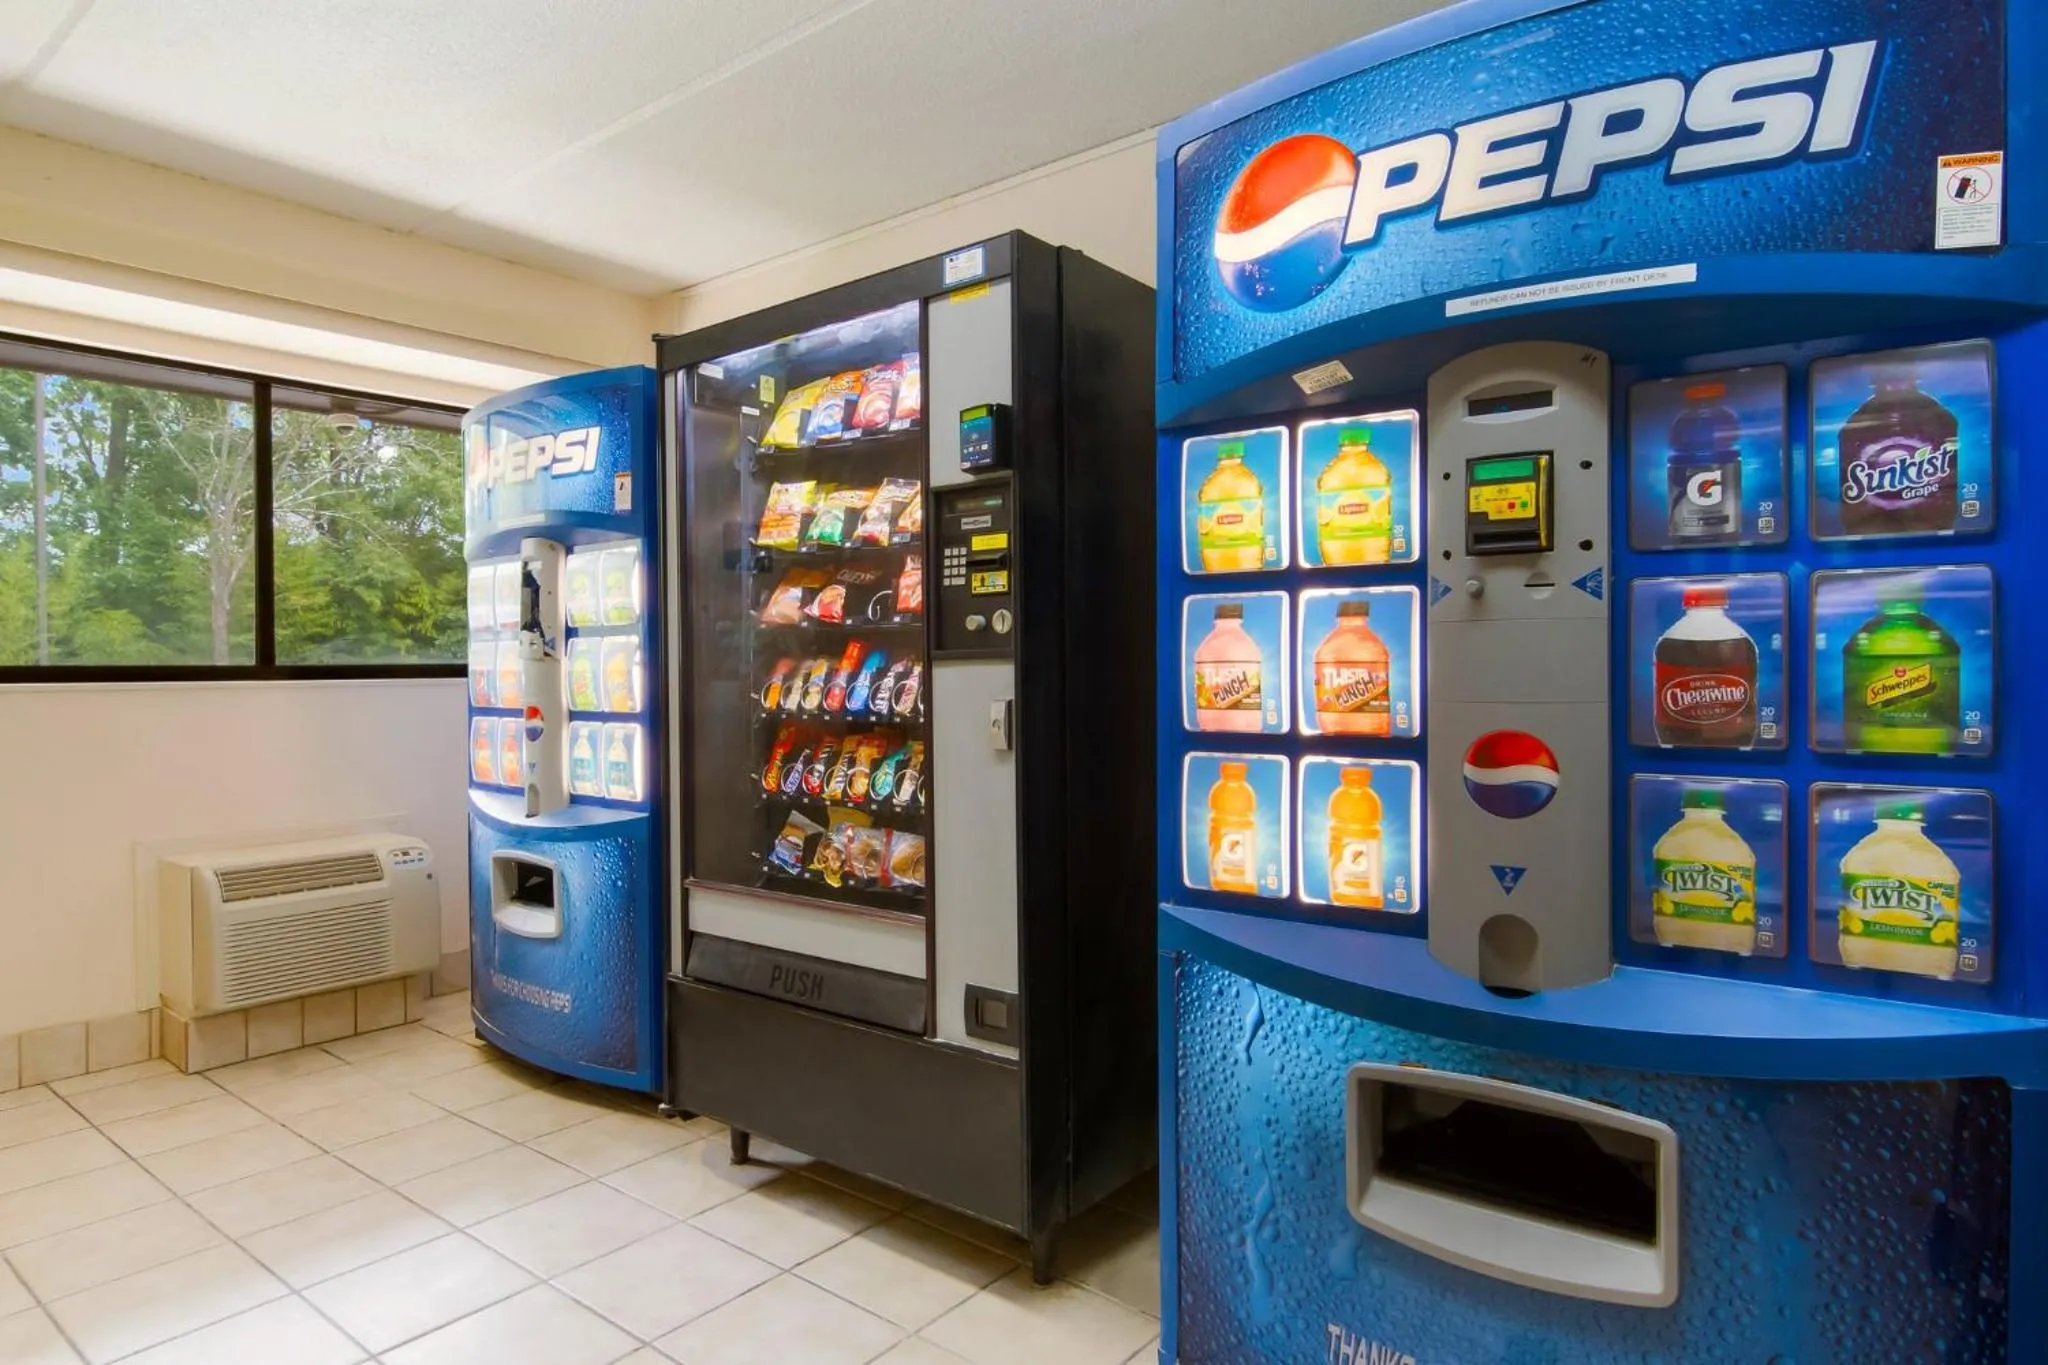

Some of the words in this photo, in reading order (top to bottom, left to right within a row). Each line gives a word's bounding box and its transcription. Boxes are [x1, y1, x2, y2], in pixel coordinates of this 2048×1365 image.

[1343, 40, 1877, 245] PEPSI
[1953, 153, 2000, 166] WARNING
[1508, 291, 1527, 303] CAN
[1528, 288, 1546, 299] NOT
[489, 426, 601, 487] PEPSI
[1687, 470, 1723, 505] G
[1842, 446, 1953, 504] Sunkist
[1961, 482, 1978, 492] 20
[1902, 483, 1940, 501] Grape
[1758, 501, 1773, 511] 20
[1666, 684, 1745, 711] Cheerwine
[1870, 673, 1928, 701] Schweppes
[1761, 706, 1775, 716] 20
[1965, 710, 1980, 720] 20
[1663, 865, 1737, 901] TWIST
[1851, 884, 1937, 921] TWIST
[1960, 937, 1977, 948] 20
[768, 963, 825, 1001] PUSH
